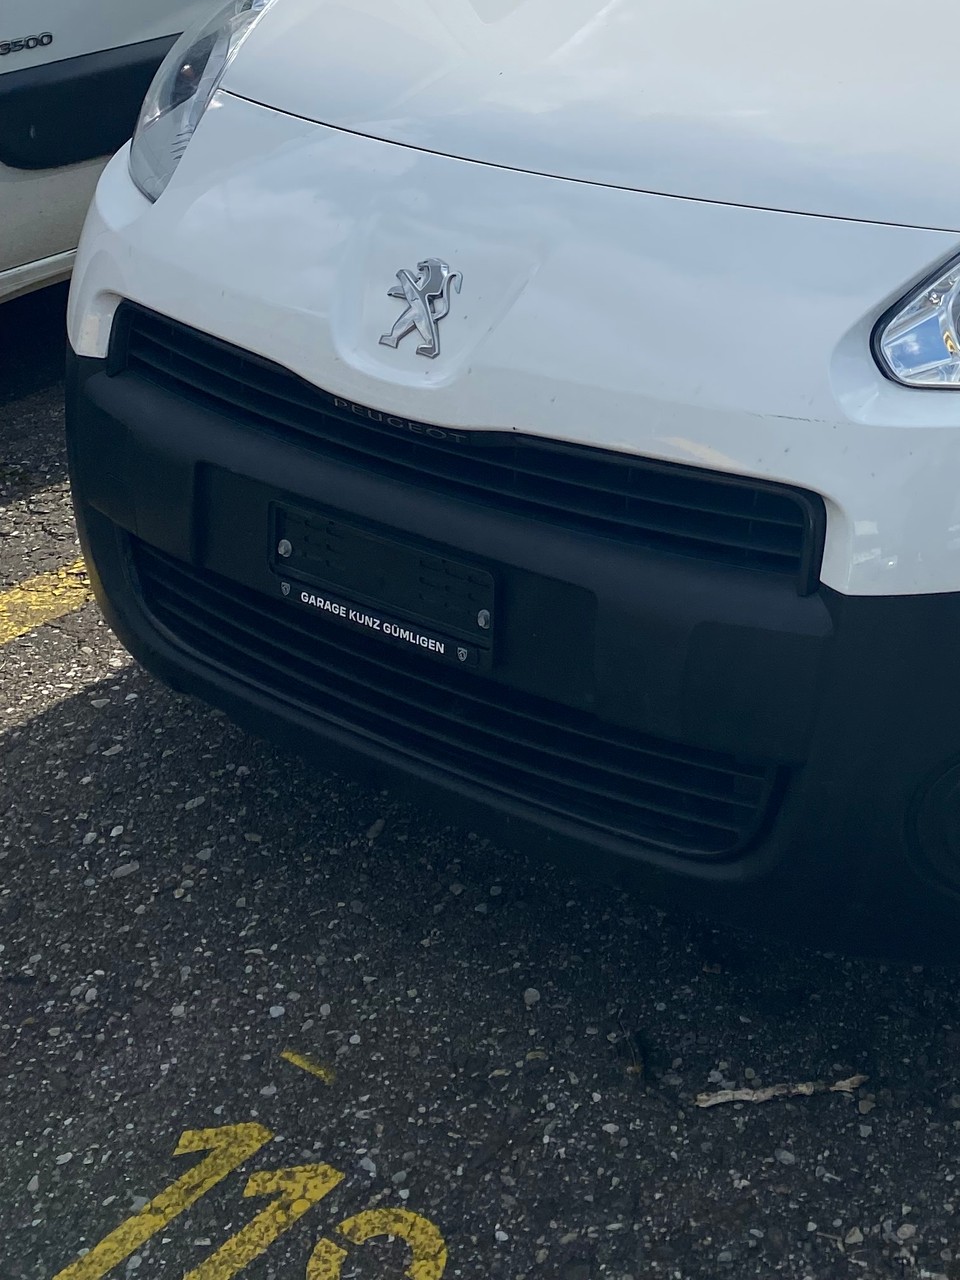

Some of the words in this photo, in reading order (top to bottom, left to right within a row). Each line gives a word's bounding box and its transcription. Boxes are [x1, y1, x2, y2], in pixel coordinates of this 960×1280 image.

[0, 31, 53, 56] 3500
[300, 591, 347, 618] GARAGE
[348, 608, 381, 631] KUNZ
[382, 623, 445, 654] GÜMLIGEN
